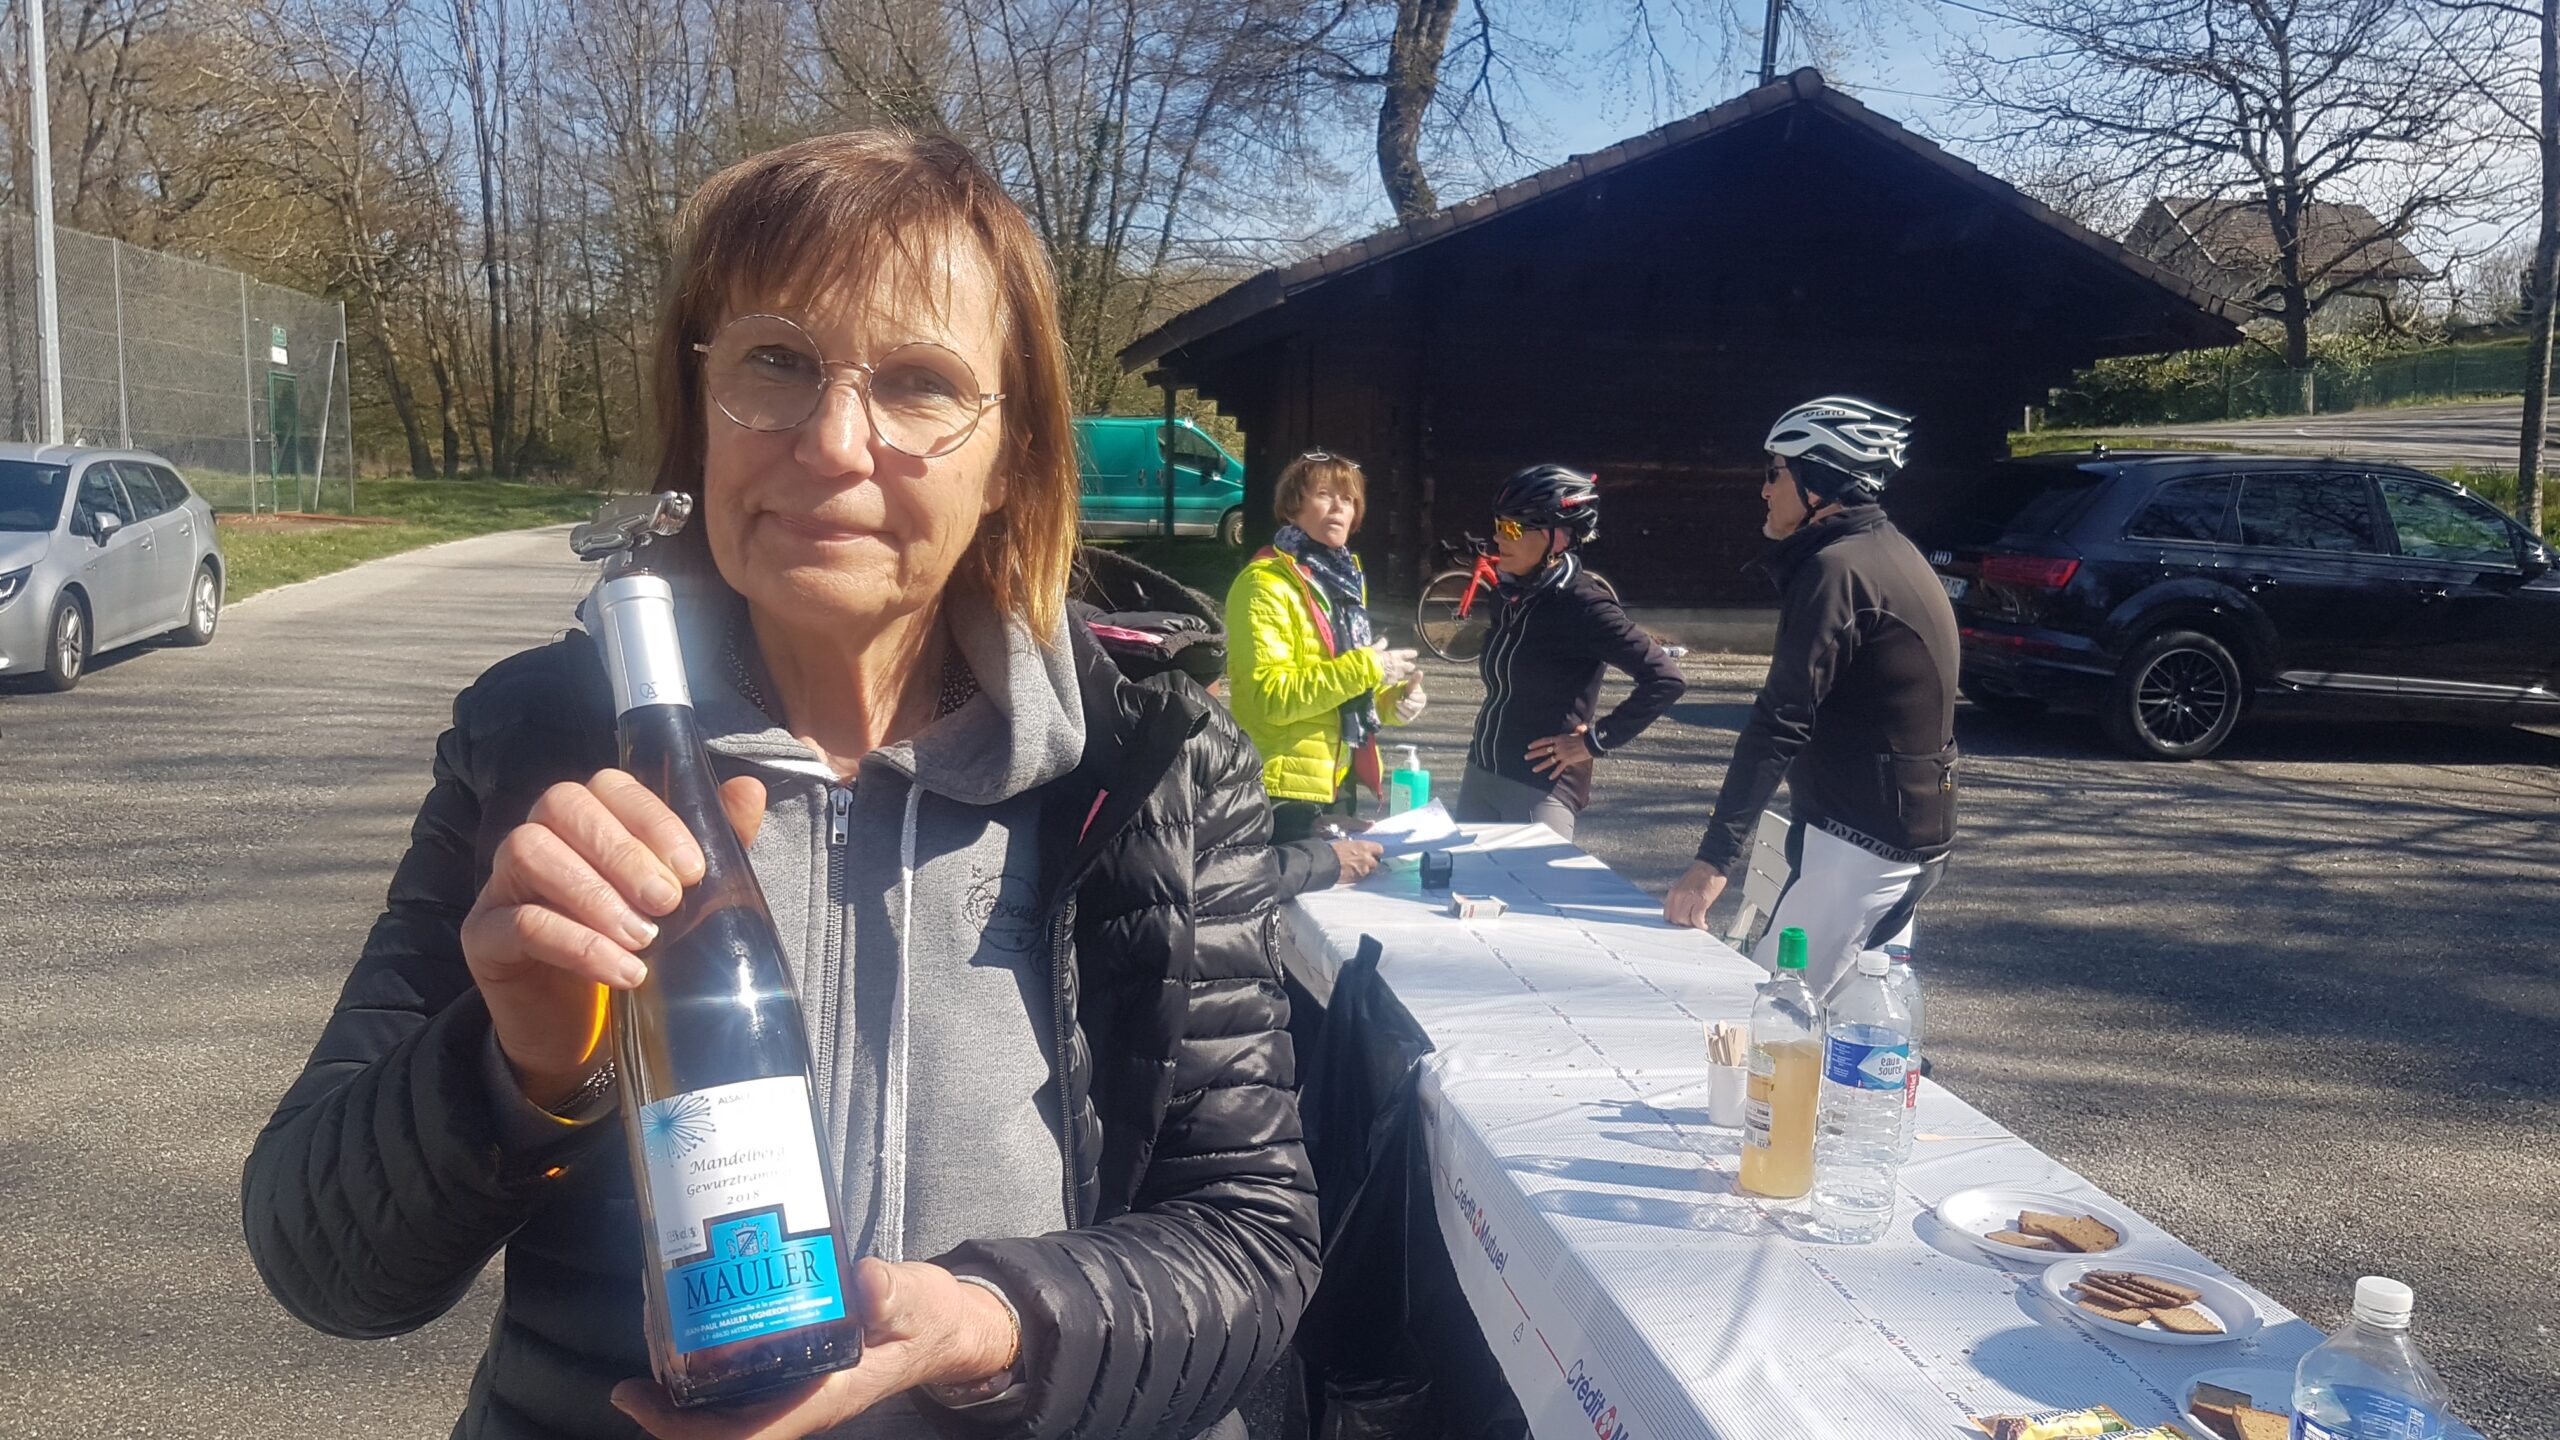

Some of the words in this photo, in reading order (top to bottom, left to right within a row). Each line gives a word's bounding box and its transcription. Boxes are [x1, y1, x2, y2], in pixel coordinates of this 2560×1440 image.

[1815, 409, 1846, 418] GIRO
[1877, 1065, 1902, 1076] source
[1880, 1057, 1896, 1067] eau
[727, 1189, 760, 1206] 2018
[1453, 1177, 1478, 1226] Crédit
[1479, 1218, 1509, 1275] Mutuel
[684, 1250, 824, 1310] MAULER
[719, 1314, 749, 1330] MAULER
[749, 1304, 790, 1322] VIGNERON
[1566, 1358, 1608, 1418] Crédit
